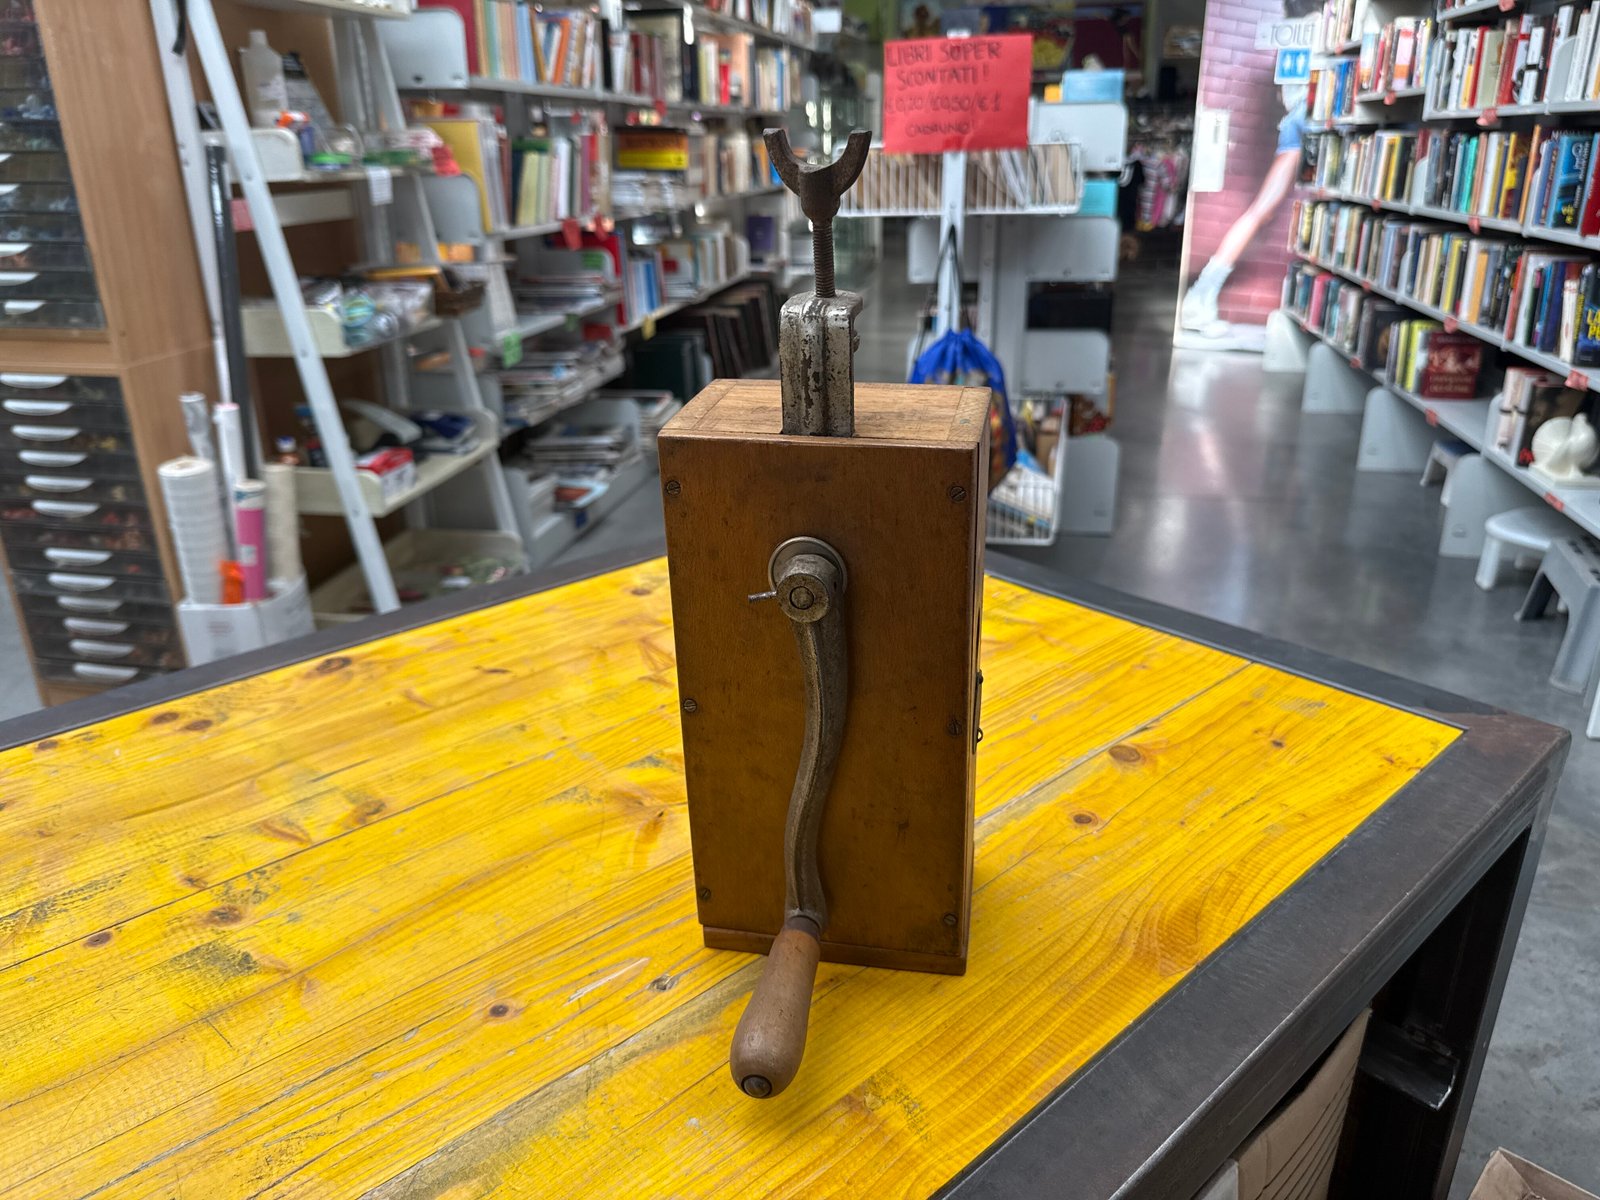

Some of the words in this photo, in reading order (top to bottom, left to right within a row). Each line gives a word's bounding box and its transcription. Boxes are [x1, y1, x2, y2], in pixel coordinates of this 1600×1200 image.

[1270, 20, 1315, 46] TOILET
[885, 45, 931, 67] LIBRI
[939, 41, 1001, 63] SUPER
